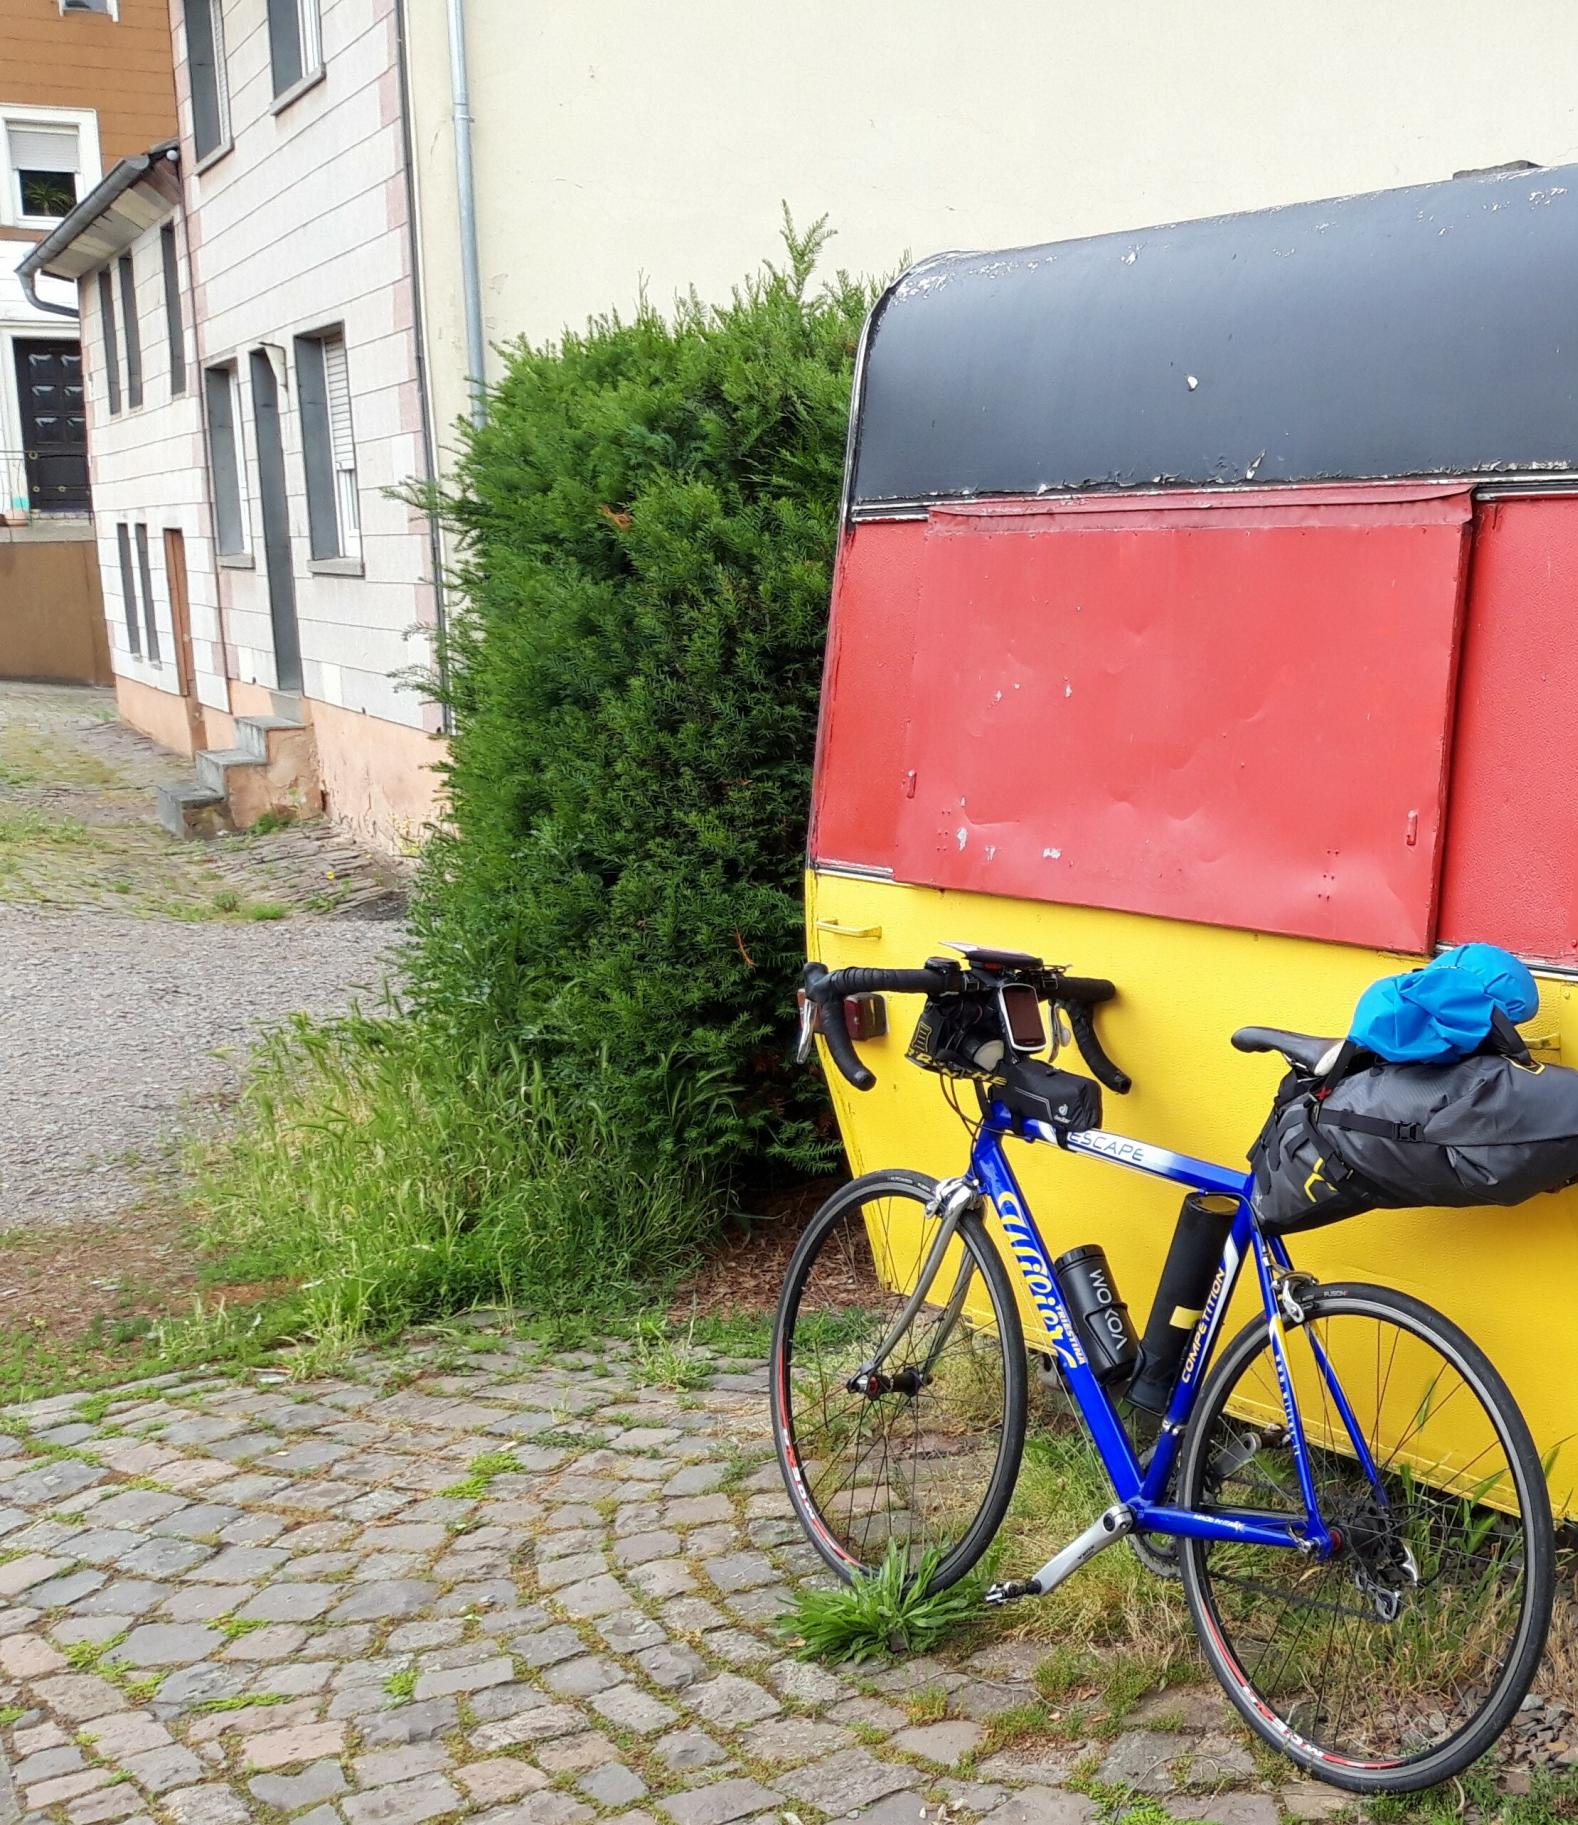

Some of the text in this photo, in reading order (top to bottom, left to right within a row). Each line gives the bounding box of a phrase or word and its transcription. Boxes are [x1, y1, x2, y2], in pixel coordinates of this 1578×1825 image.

[1068, 1131, 1145, 1162] ESCAPE
[1055, 1303, 1088, 1365] TRIESTINA
[1181, 1266, 1226, 1384] COMPETITION
